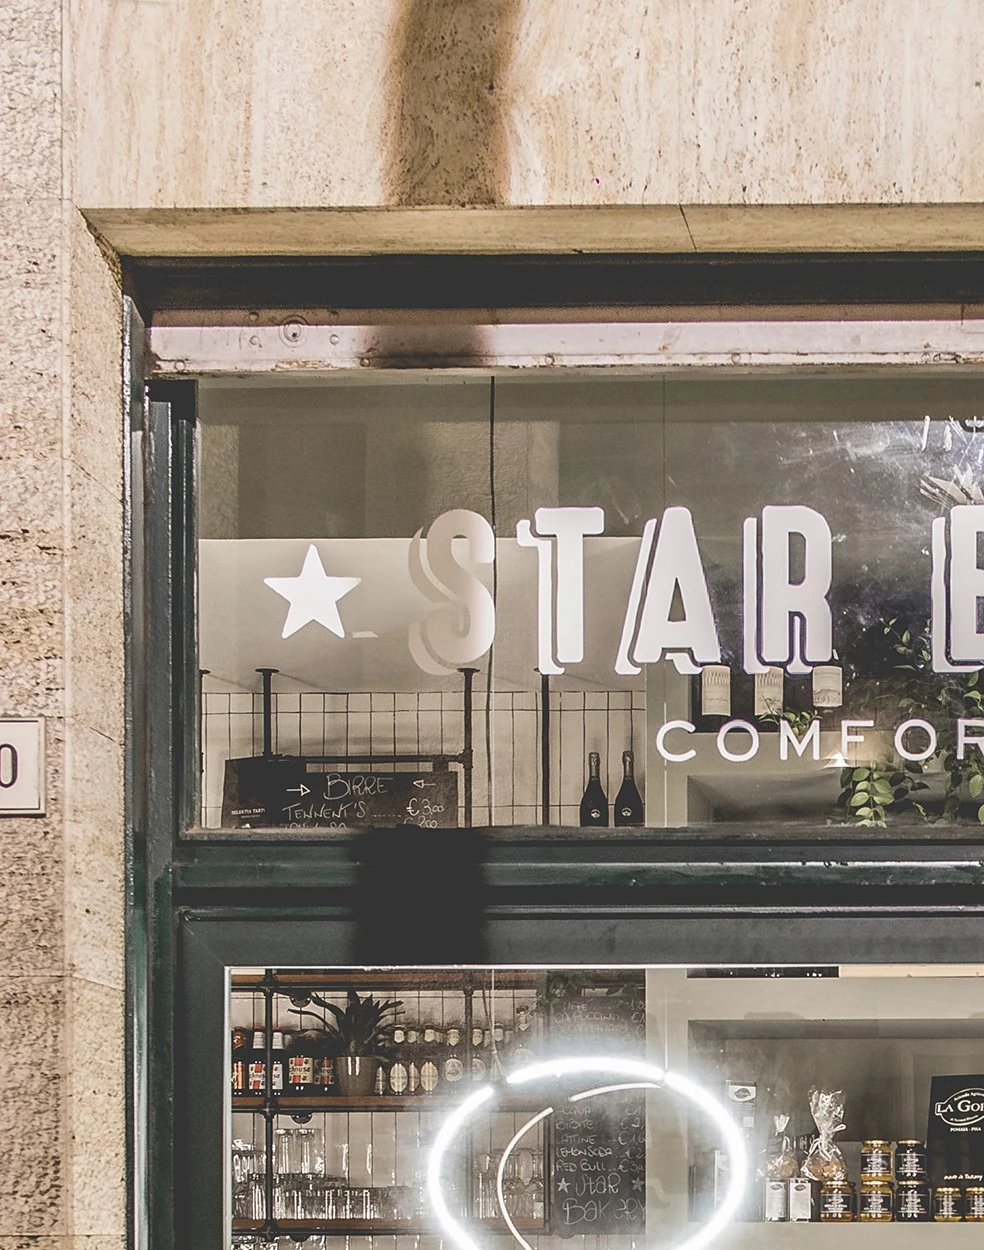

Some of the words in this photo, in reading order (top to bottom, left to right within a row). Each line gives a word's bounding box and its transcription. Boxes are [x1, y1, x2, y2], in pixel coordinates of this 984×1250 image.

[407, 504, 836, 676] STAR
[322, 773, 394, 801] BIRRE
[282, 801, 367, 820] TENNENT'S
[937, 1104, 954, 1113] LA
